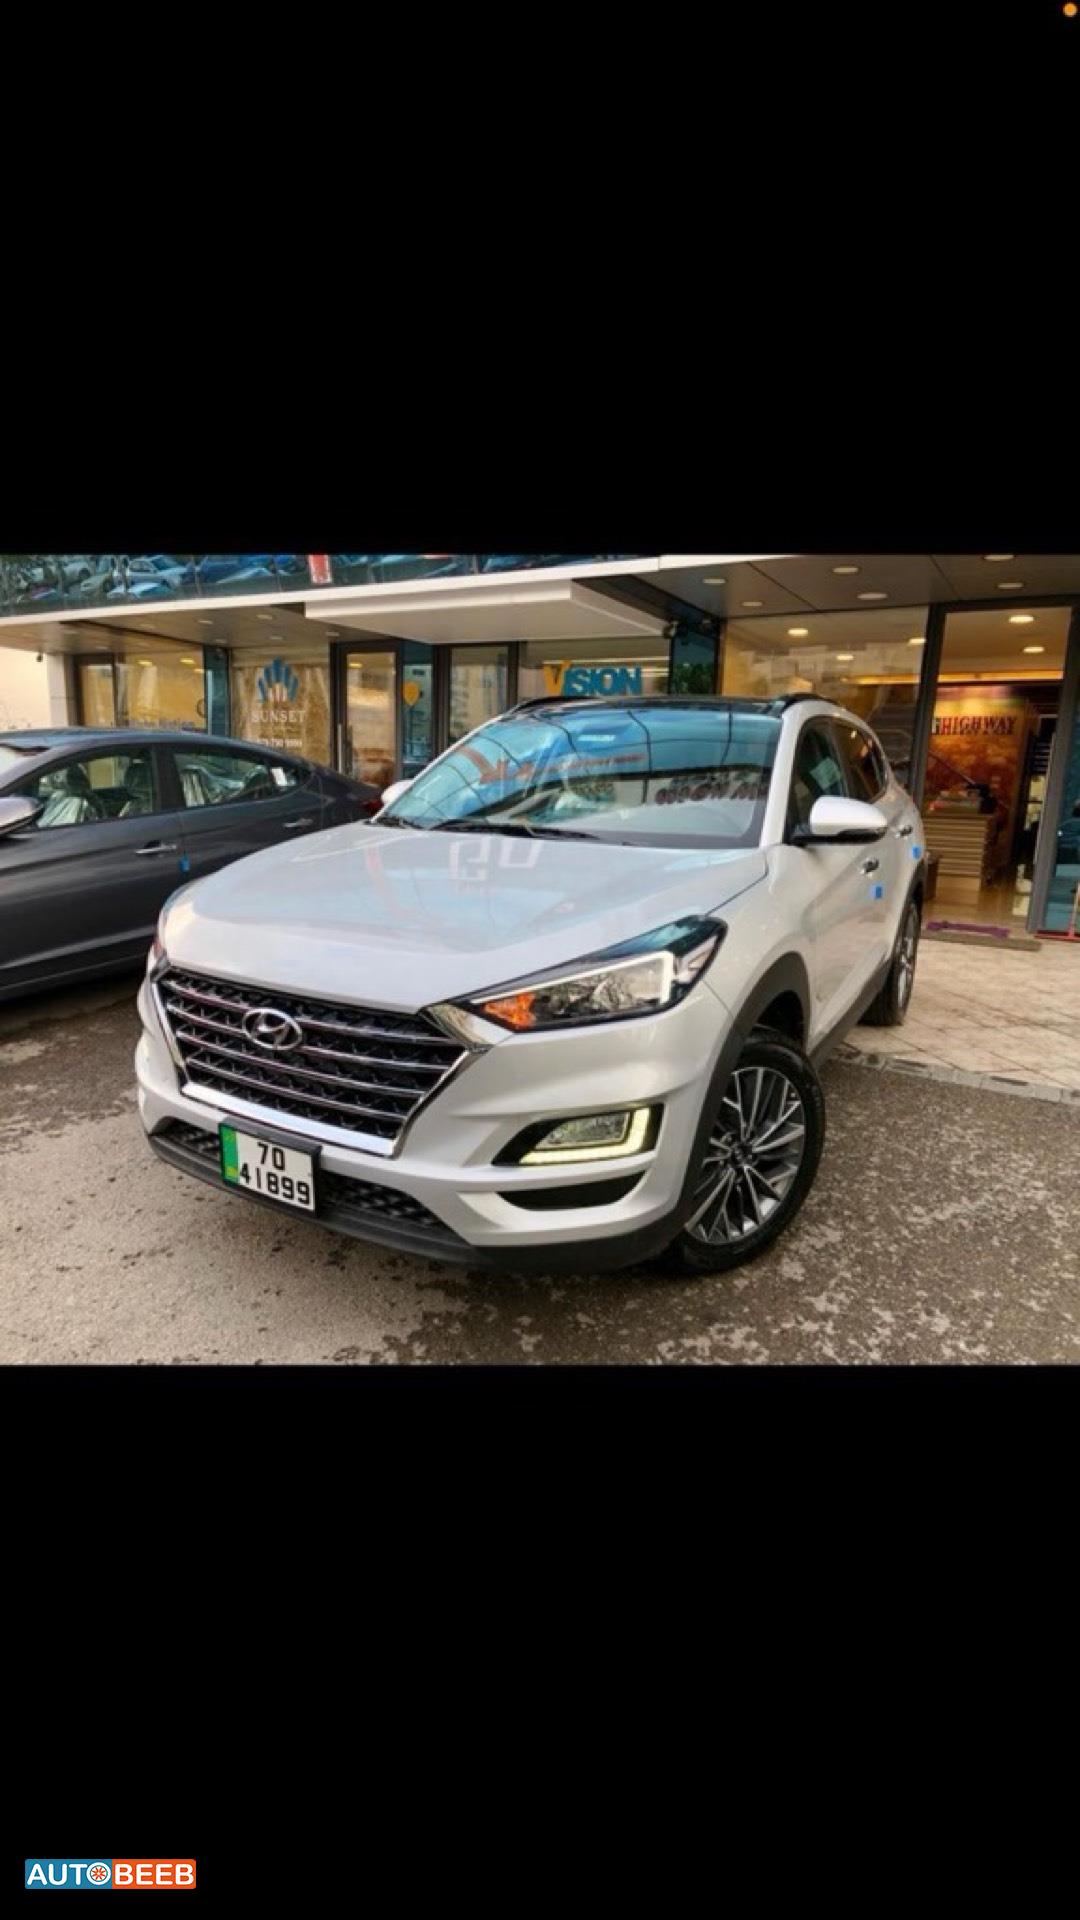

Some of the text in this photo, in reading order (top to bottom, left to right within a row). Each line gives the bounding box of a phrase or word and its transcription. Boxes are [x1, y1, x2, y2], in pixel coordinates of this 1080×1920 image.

[543, 660, 643, 696] VISION
[249, 710, 306, 723] SUNSET
[257, 1141, 285, 1170] 70
[240, 1163, 310, 1205] 41899
